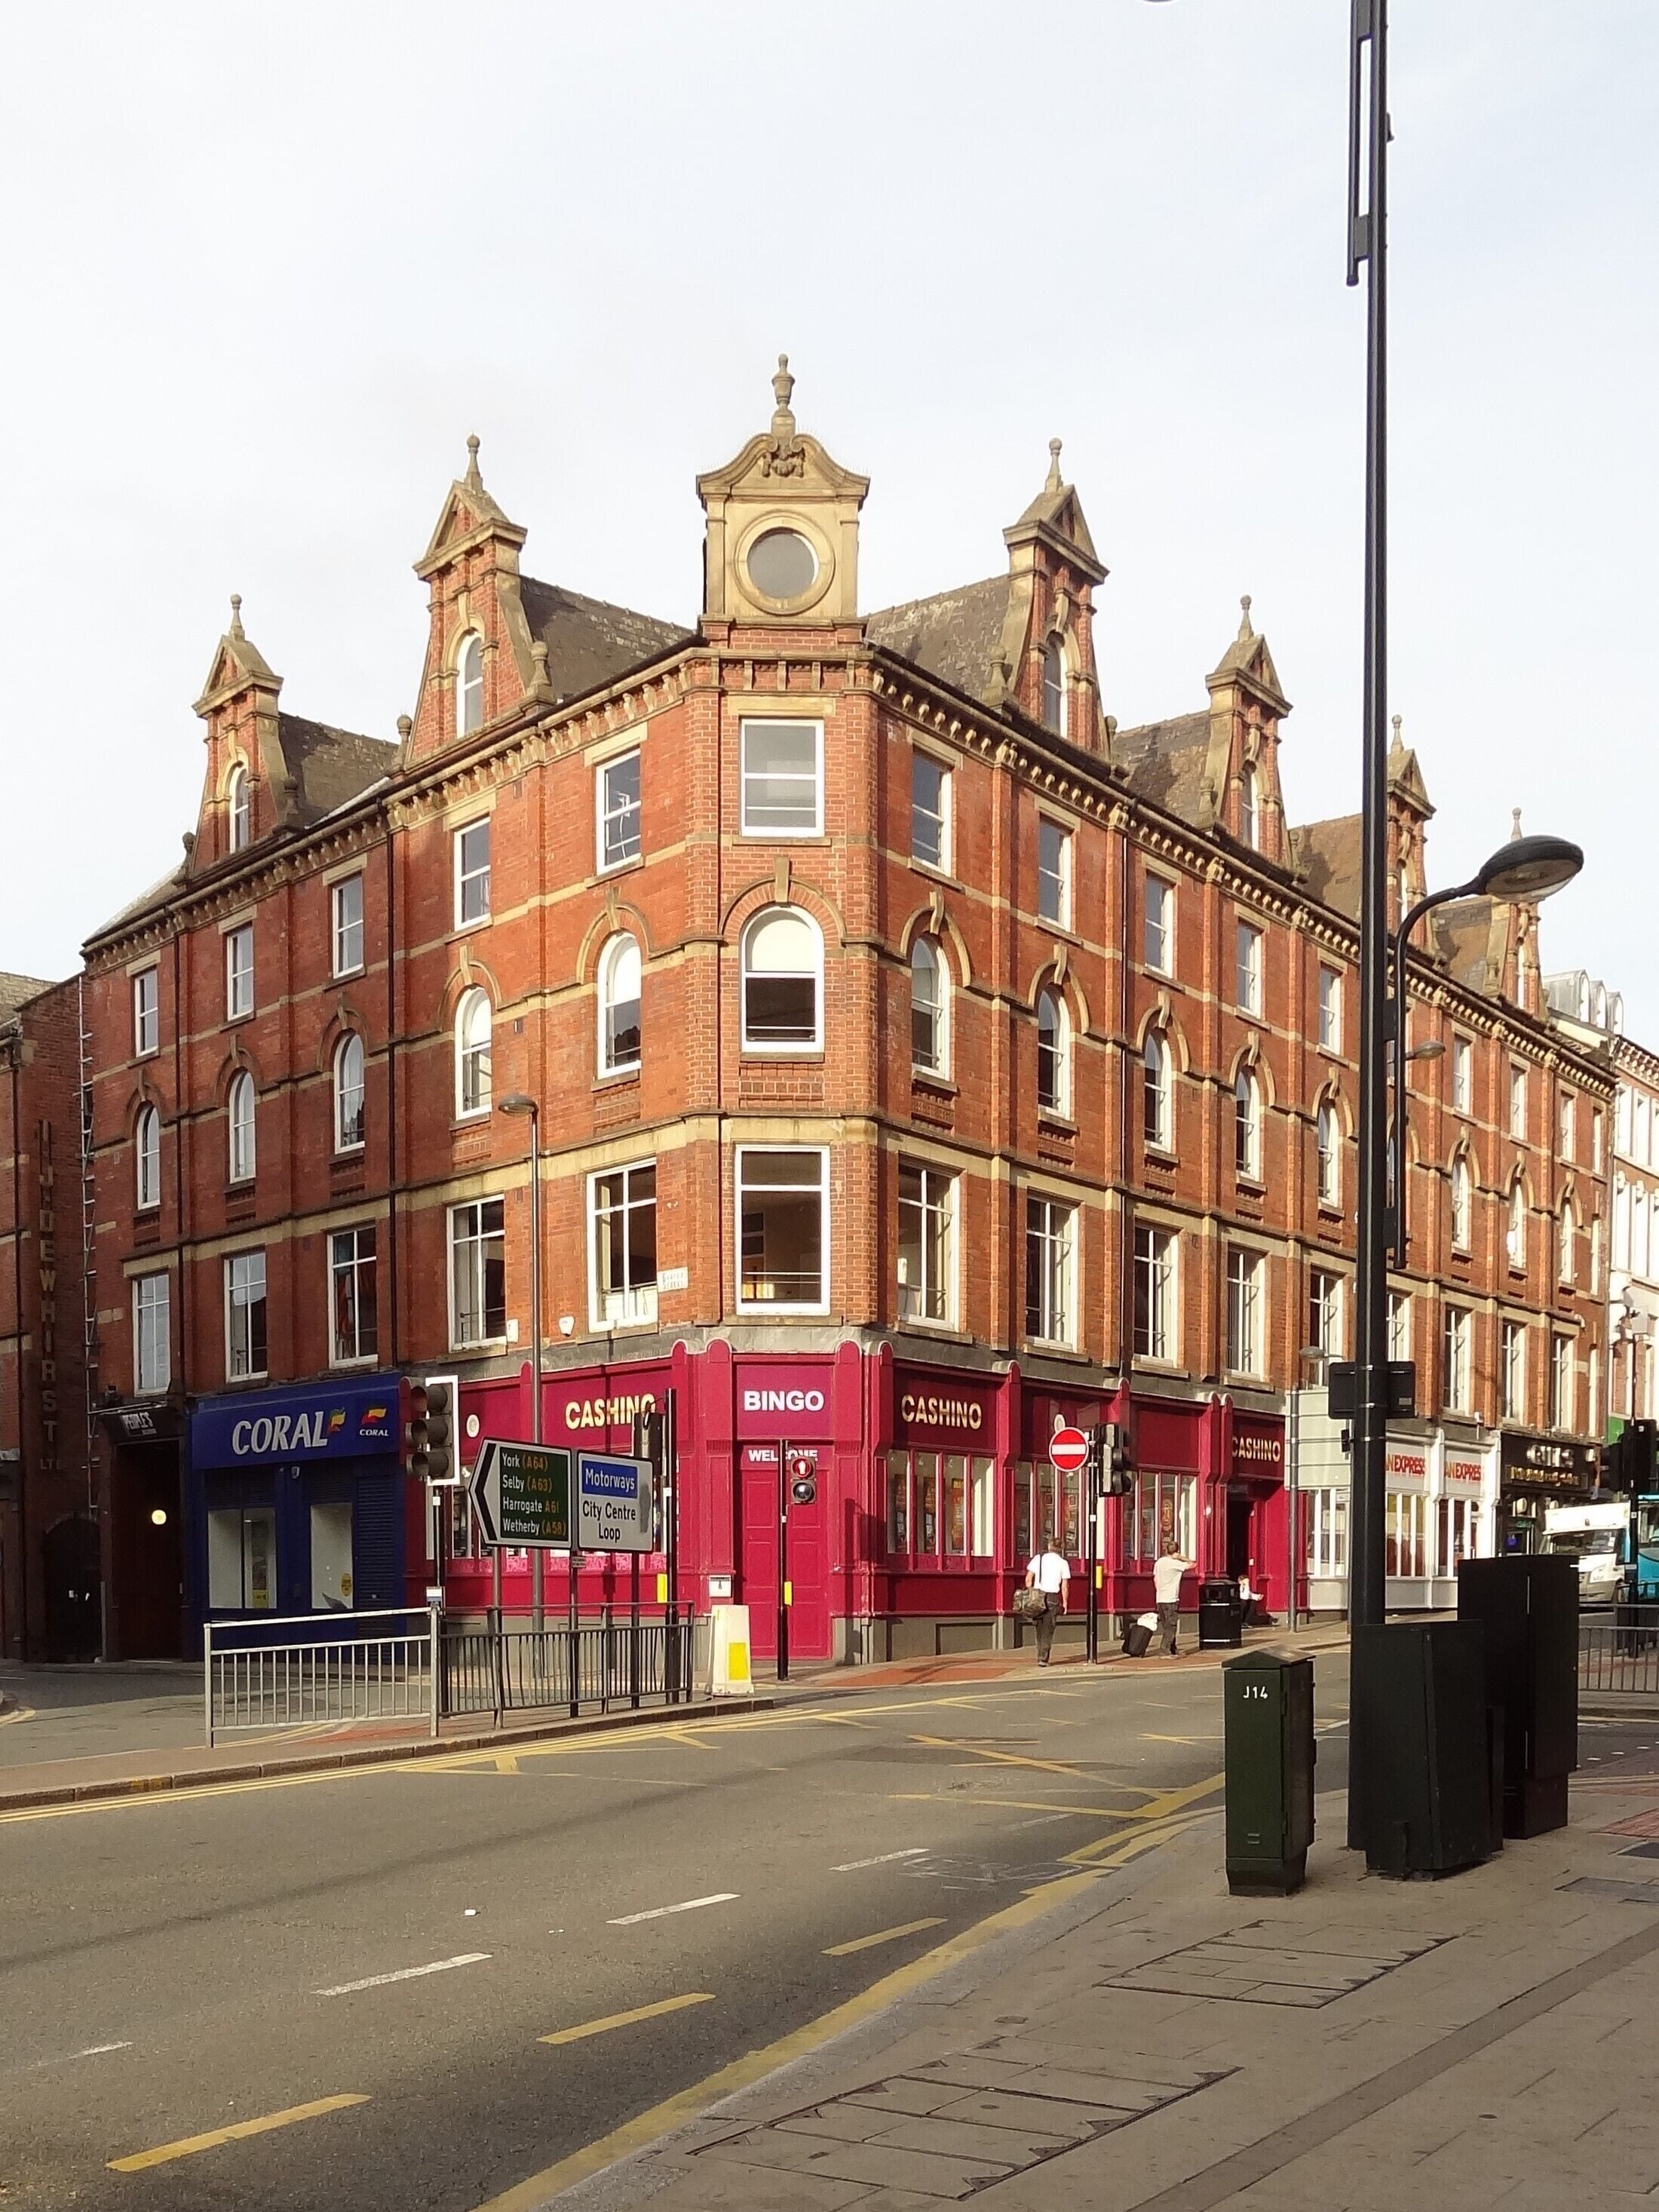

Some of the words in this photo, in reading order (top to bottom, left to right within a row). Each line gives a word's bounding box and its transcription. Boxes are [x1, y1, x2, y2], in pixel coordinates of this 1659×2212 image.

[744, 1390, 824, 1412] BINGO
[901, 1394, 982, 1429] CASHINO
[232, 1410, 329, 1456] CORAL
[360, 1428, 389, 1437] CORAL
[748, 1449, 818, 1462] WELOE
[1231, 1436, 1281, 1462] CASHINO
[502, 1453, 521, 1468] York
[523, 1454, 548, 1472] (A64)
[502, 1474, 525, 1493] Selby
[527, 1476, 553, 1493] (A63)
[585, 1467, 635, 1493] Motorways
[503, 1496, 543, 1514] Harrogate
[545, 1500, 559, 1514] A61
[582, 1500, 603, 1521] City
[606, 1502, 636, 1520] Centre
[503, 1517, 540, 1536] Wetherby
[542, 1520, 567, 1536] (A58)
[599, 1523, 621, 1544] Loop
[1243, 1685, 1268, 1699] J14
